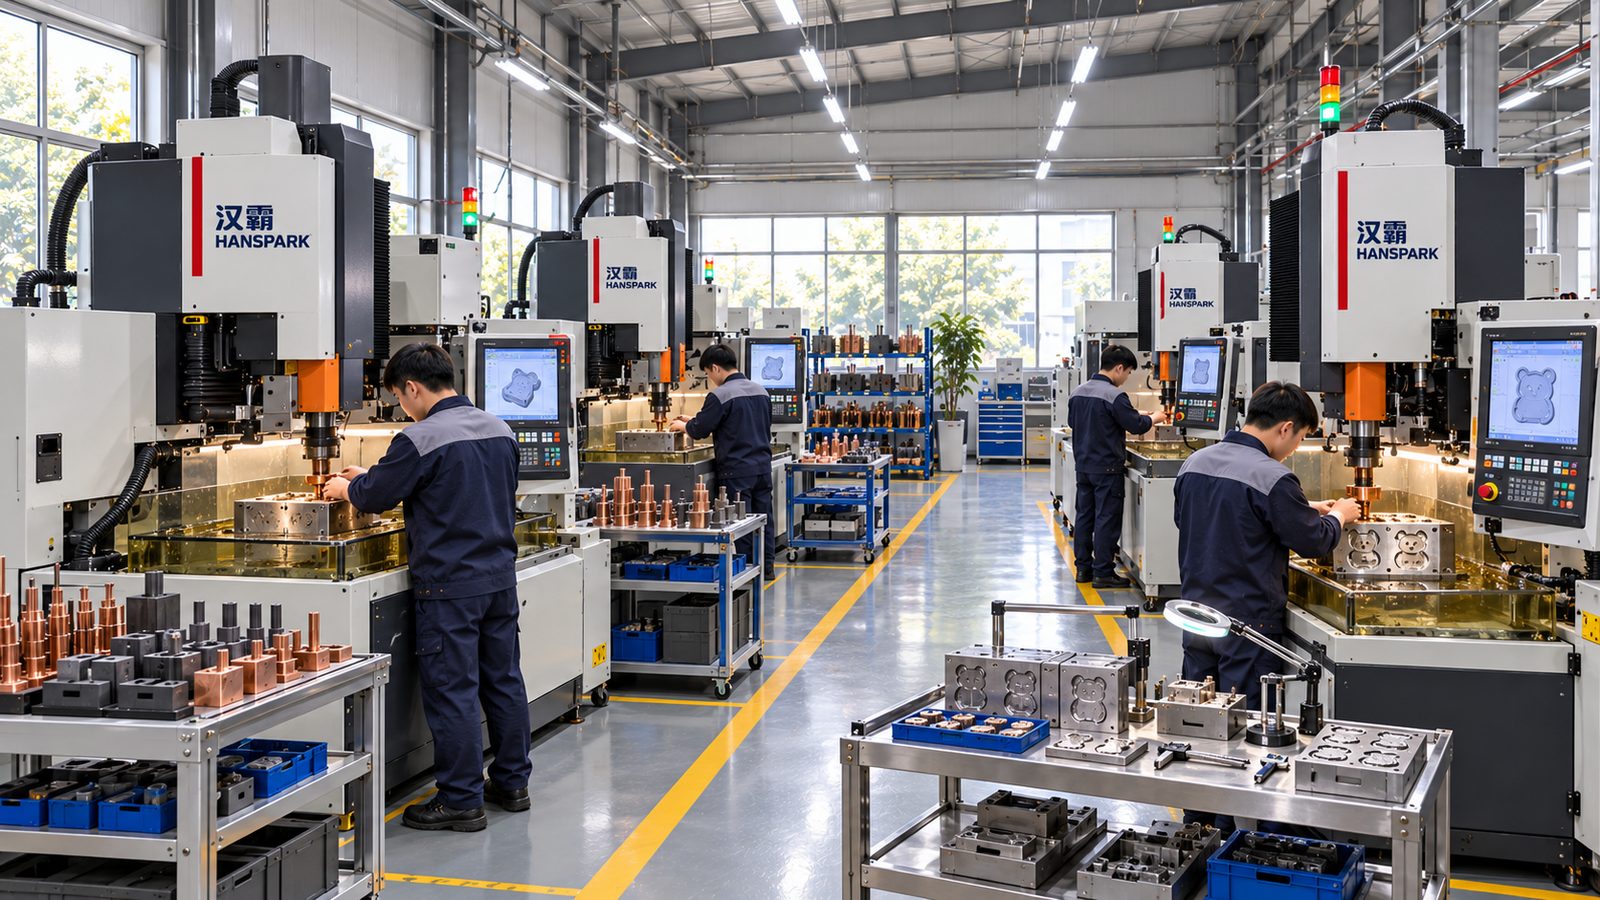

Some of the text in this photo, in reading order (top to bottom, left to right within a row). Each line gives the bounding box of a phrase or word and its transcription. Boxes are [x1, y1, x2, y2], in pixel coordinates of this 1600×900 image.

[216, 205, 273, 231] 汉霸
[1357, 220, 1407, 244] 汉霸
[216, 235, 310, 248] HANSPARK
[1357, 248, 1439, 260] HANSPARK
[606, 266, 638, 280] 汉霸
[606, 281, 657, 289] HANSPARK
[1169, 300, 1214, 308] HANSPARK
